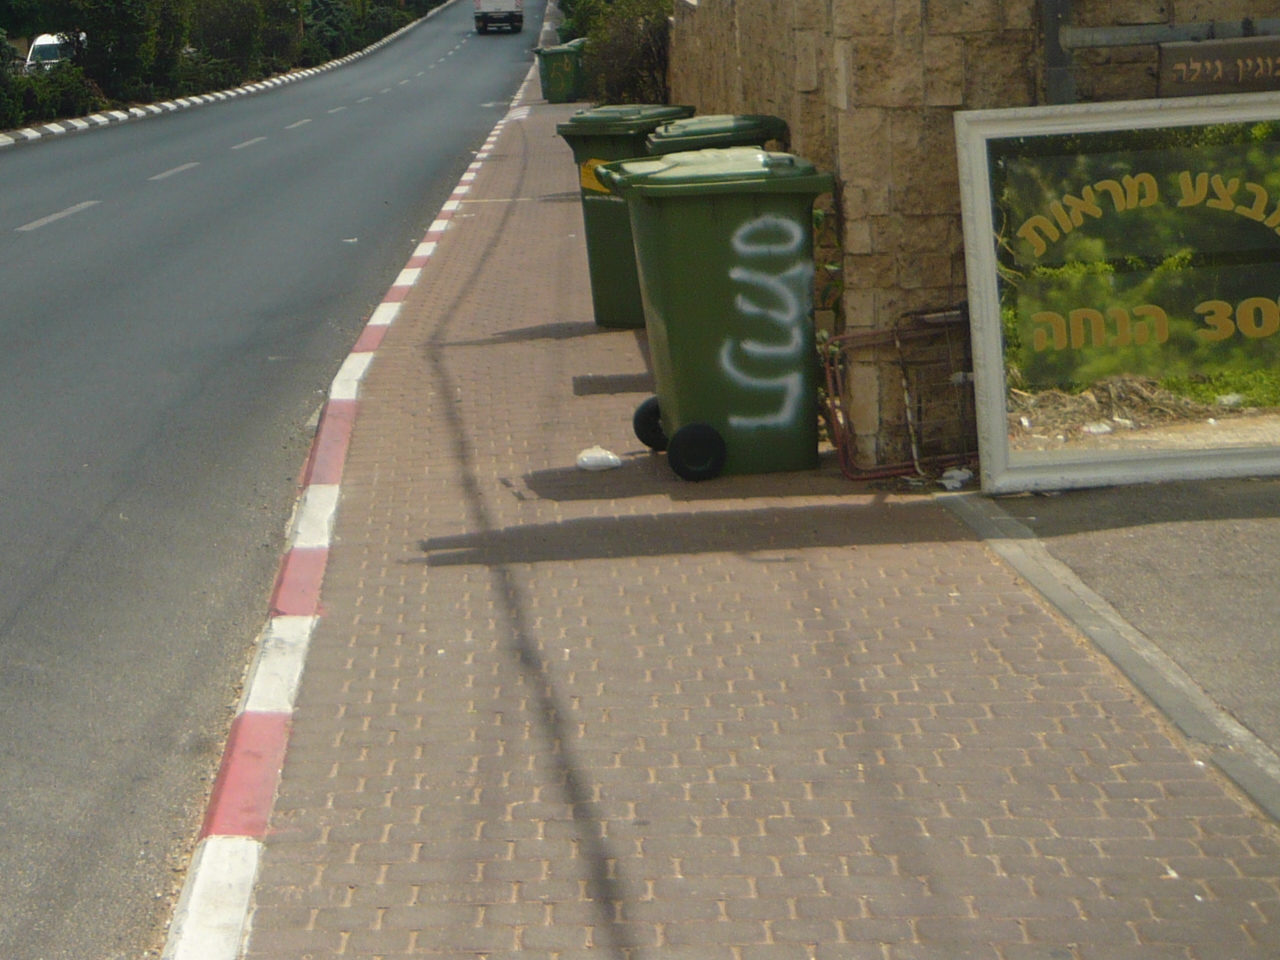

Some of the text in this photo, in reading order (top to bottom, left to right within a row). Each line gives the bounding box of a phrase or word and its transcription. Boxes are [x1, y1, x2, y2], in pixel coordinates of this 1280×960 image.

[1236, 55, 1280, 83] וגין
[1016, 170, 1280, 258] בצע מראות
[1031, 296, 1280, 352] 30 הנחה
